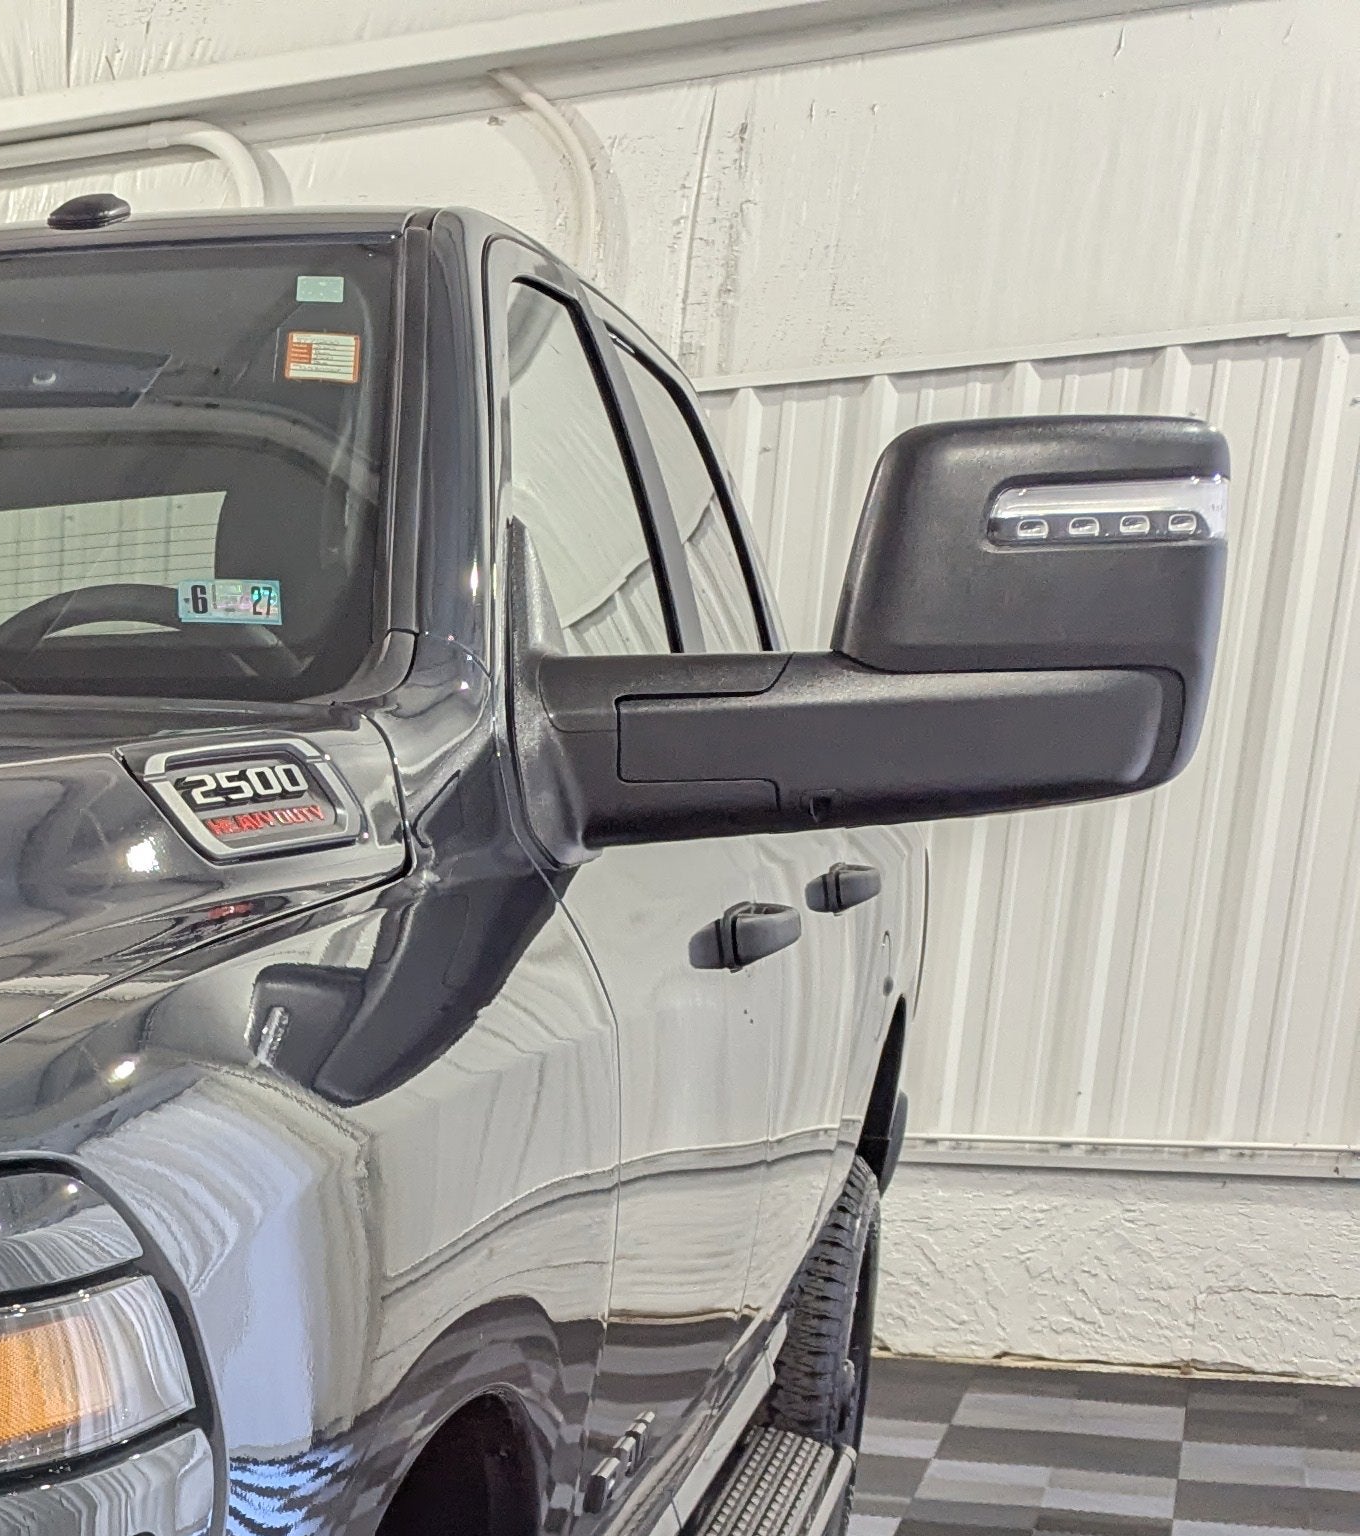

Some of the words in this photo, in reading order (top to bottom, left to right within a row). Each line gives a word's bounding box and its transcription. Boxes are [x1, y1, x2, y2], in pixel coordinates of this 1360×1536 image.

[190, 584, 209, 615] 6
[250, 585, 273, 617] 27
[179, 763, 309, 809] 2500
[205, 811, 275, 836] HEAVY
[274, 804, 326, 828] DUTY
